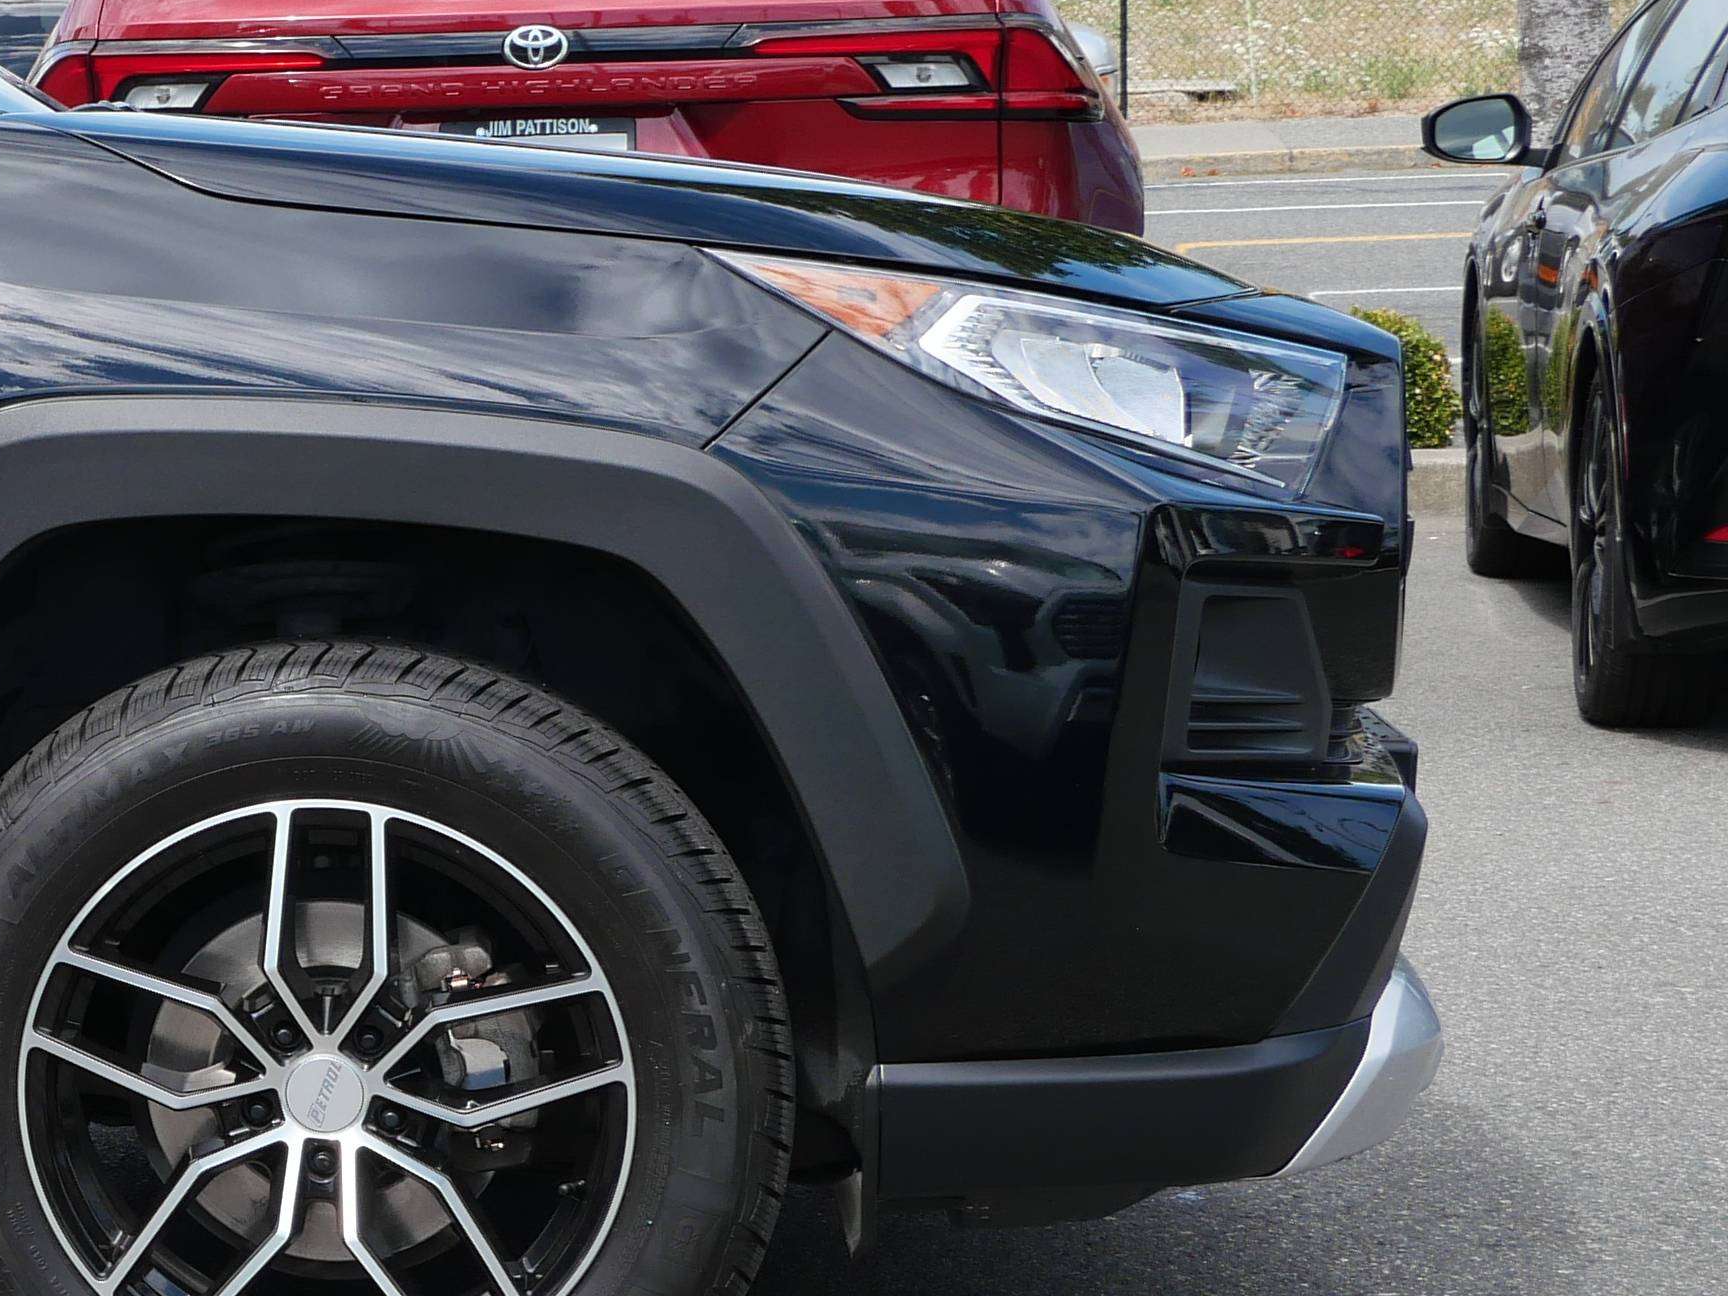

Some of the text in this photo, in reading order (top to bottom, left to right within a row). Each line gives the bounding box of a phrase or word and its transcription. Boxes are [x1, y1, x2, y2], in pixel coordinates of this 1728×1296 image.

[319, 74, 757, 99] GRAND HIGHLANDER
[487, 118, 590, 137] JIM PATTISON
[307, 1061, 343, 1128] PETROL
